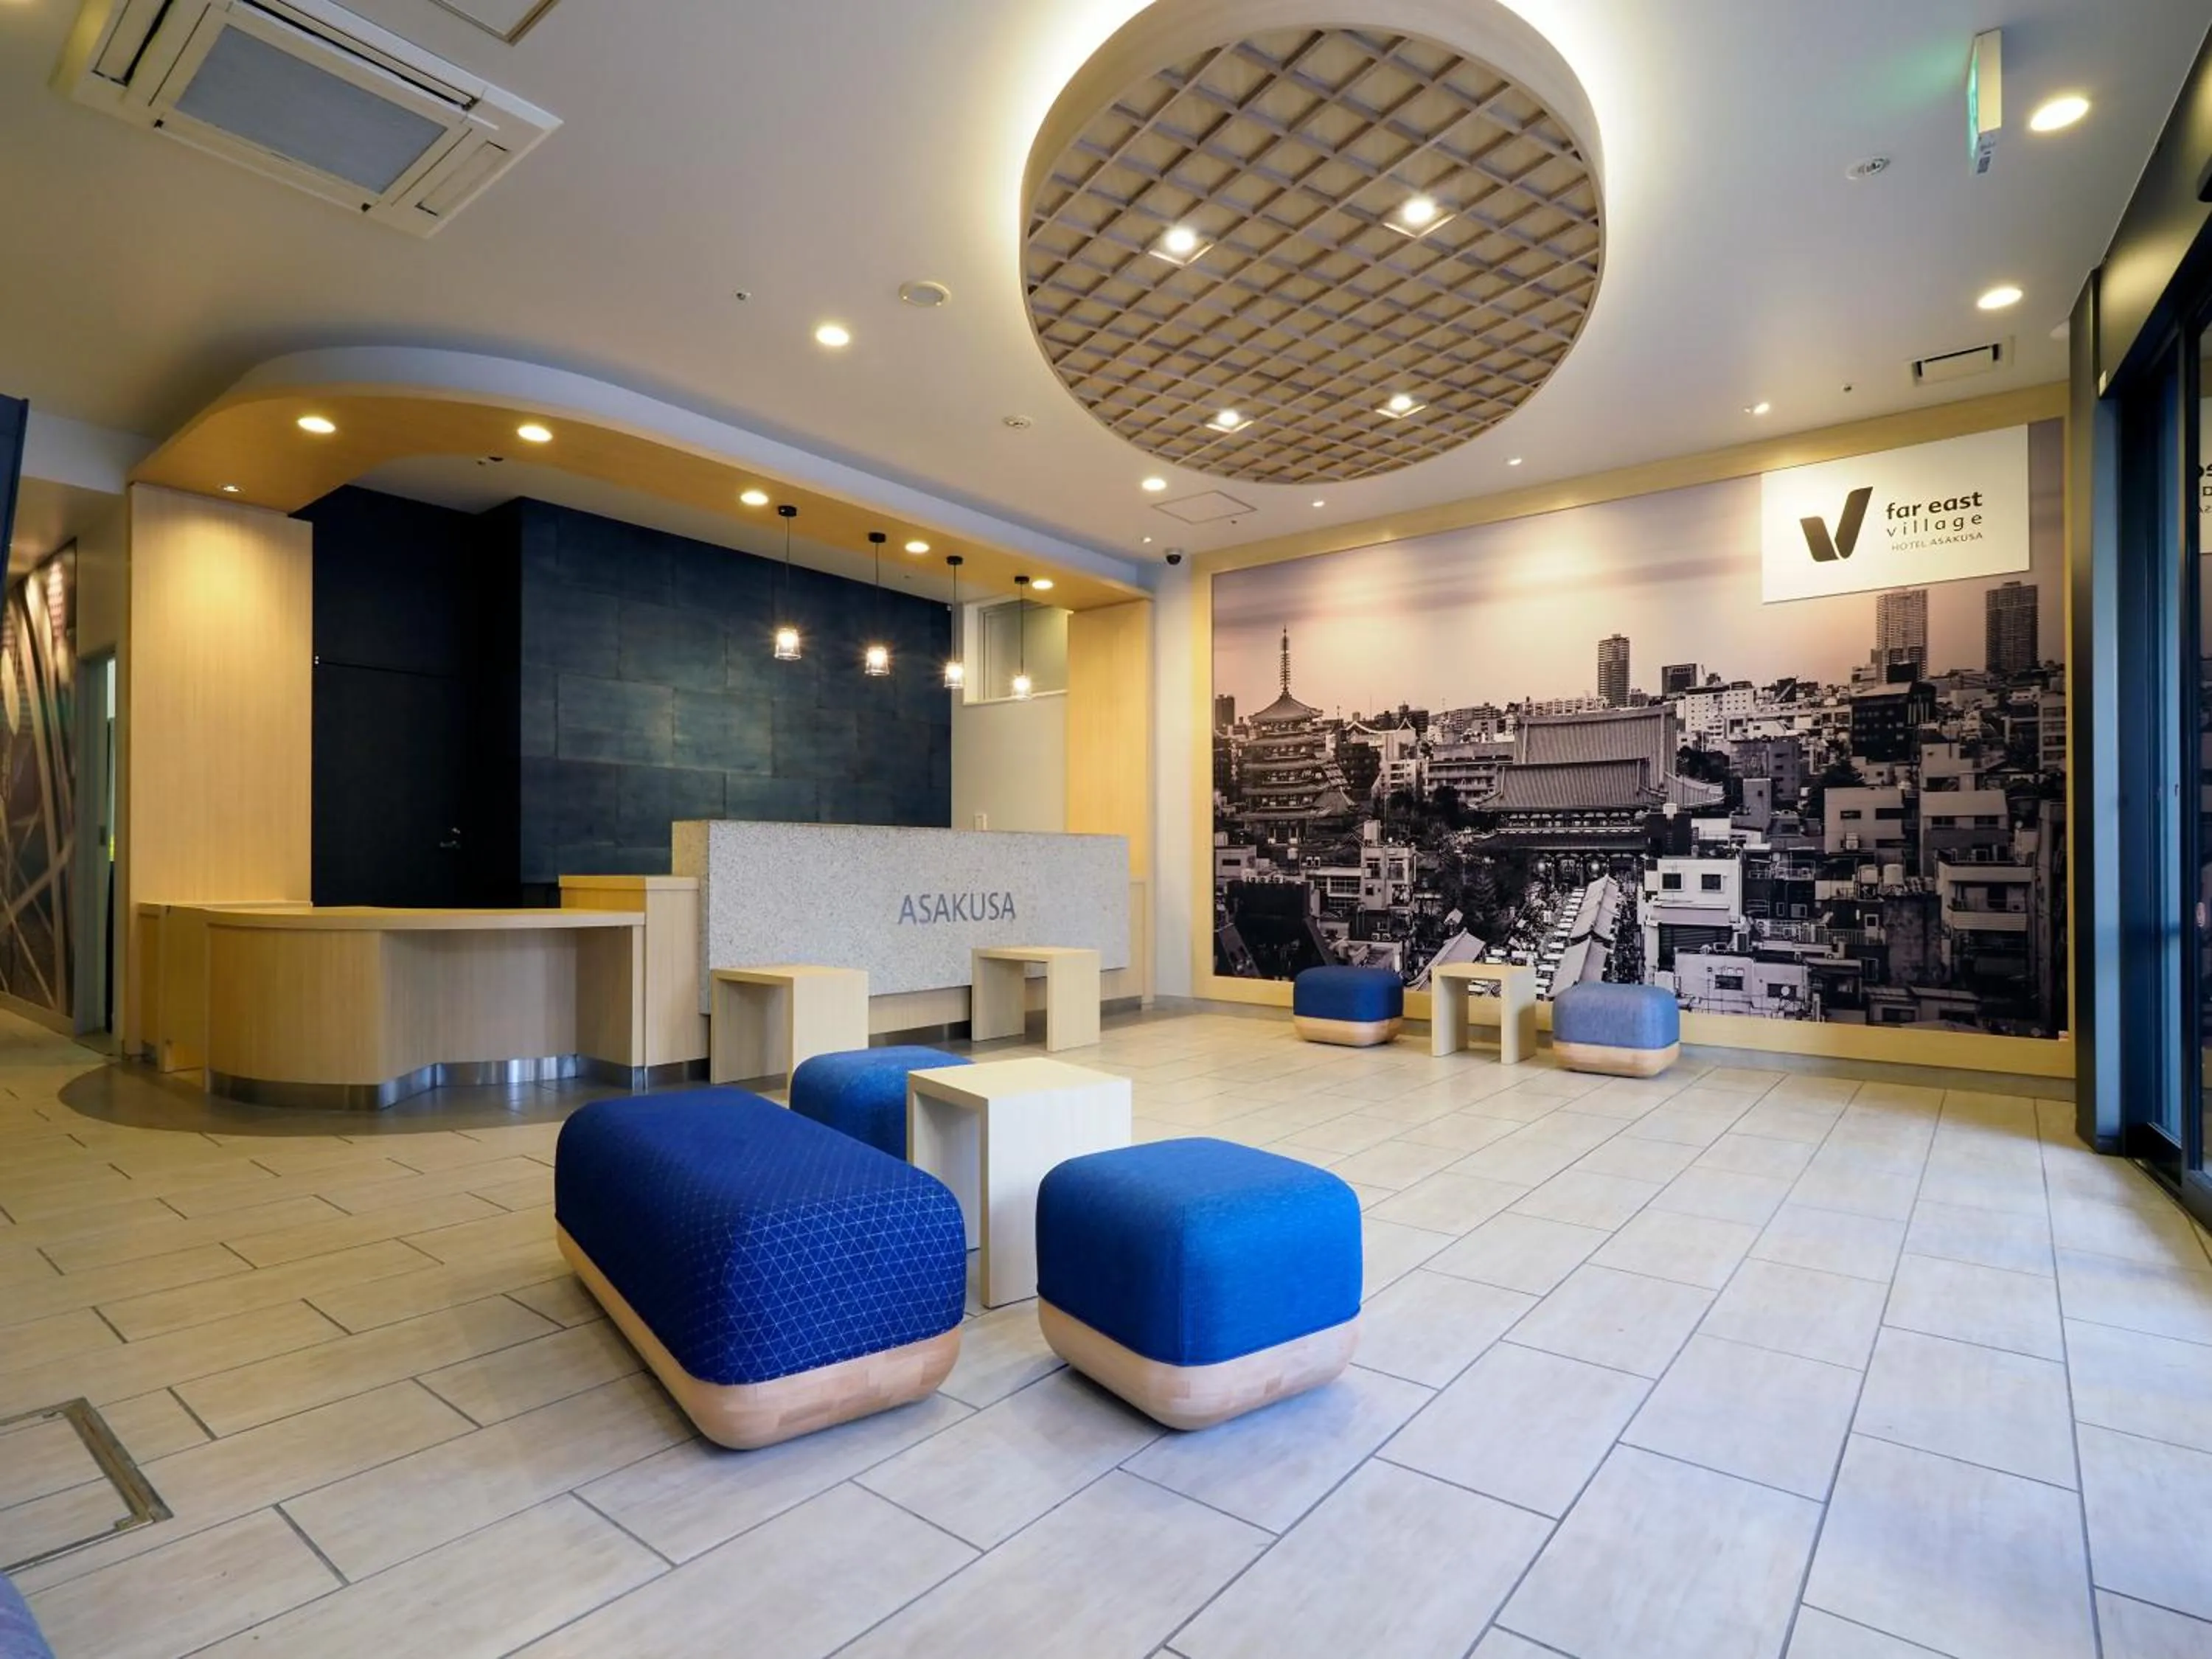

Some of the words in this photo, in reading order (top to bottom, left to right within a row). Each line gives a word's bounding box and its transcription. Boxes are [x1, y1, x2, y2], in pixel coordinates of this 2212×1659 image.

[1886, 502, 1921, 520] far
[1928, 491, 1983, 514] east
[1886, 514, 1983, 538] village
[1891, 540, 1927, 552] HOTEL
[1930, 532, 1983, 546] ASAKUSA
[897, 891, 1016, 925] ASAKUSA
